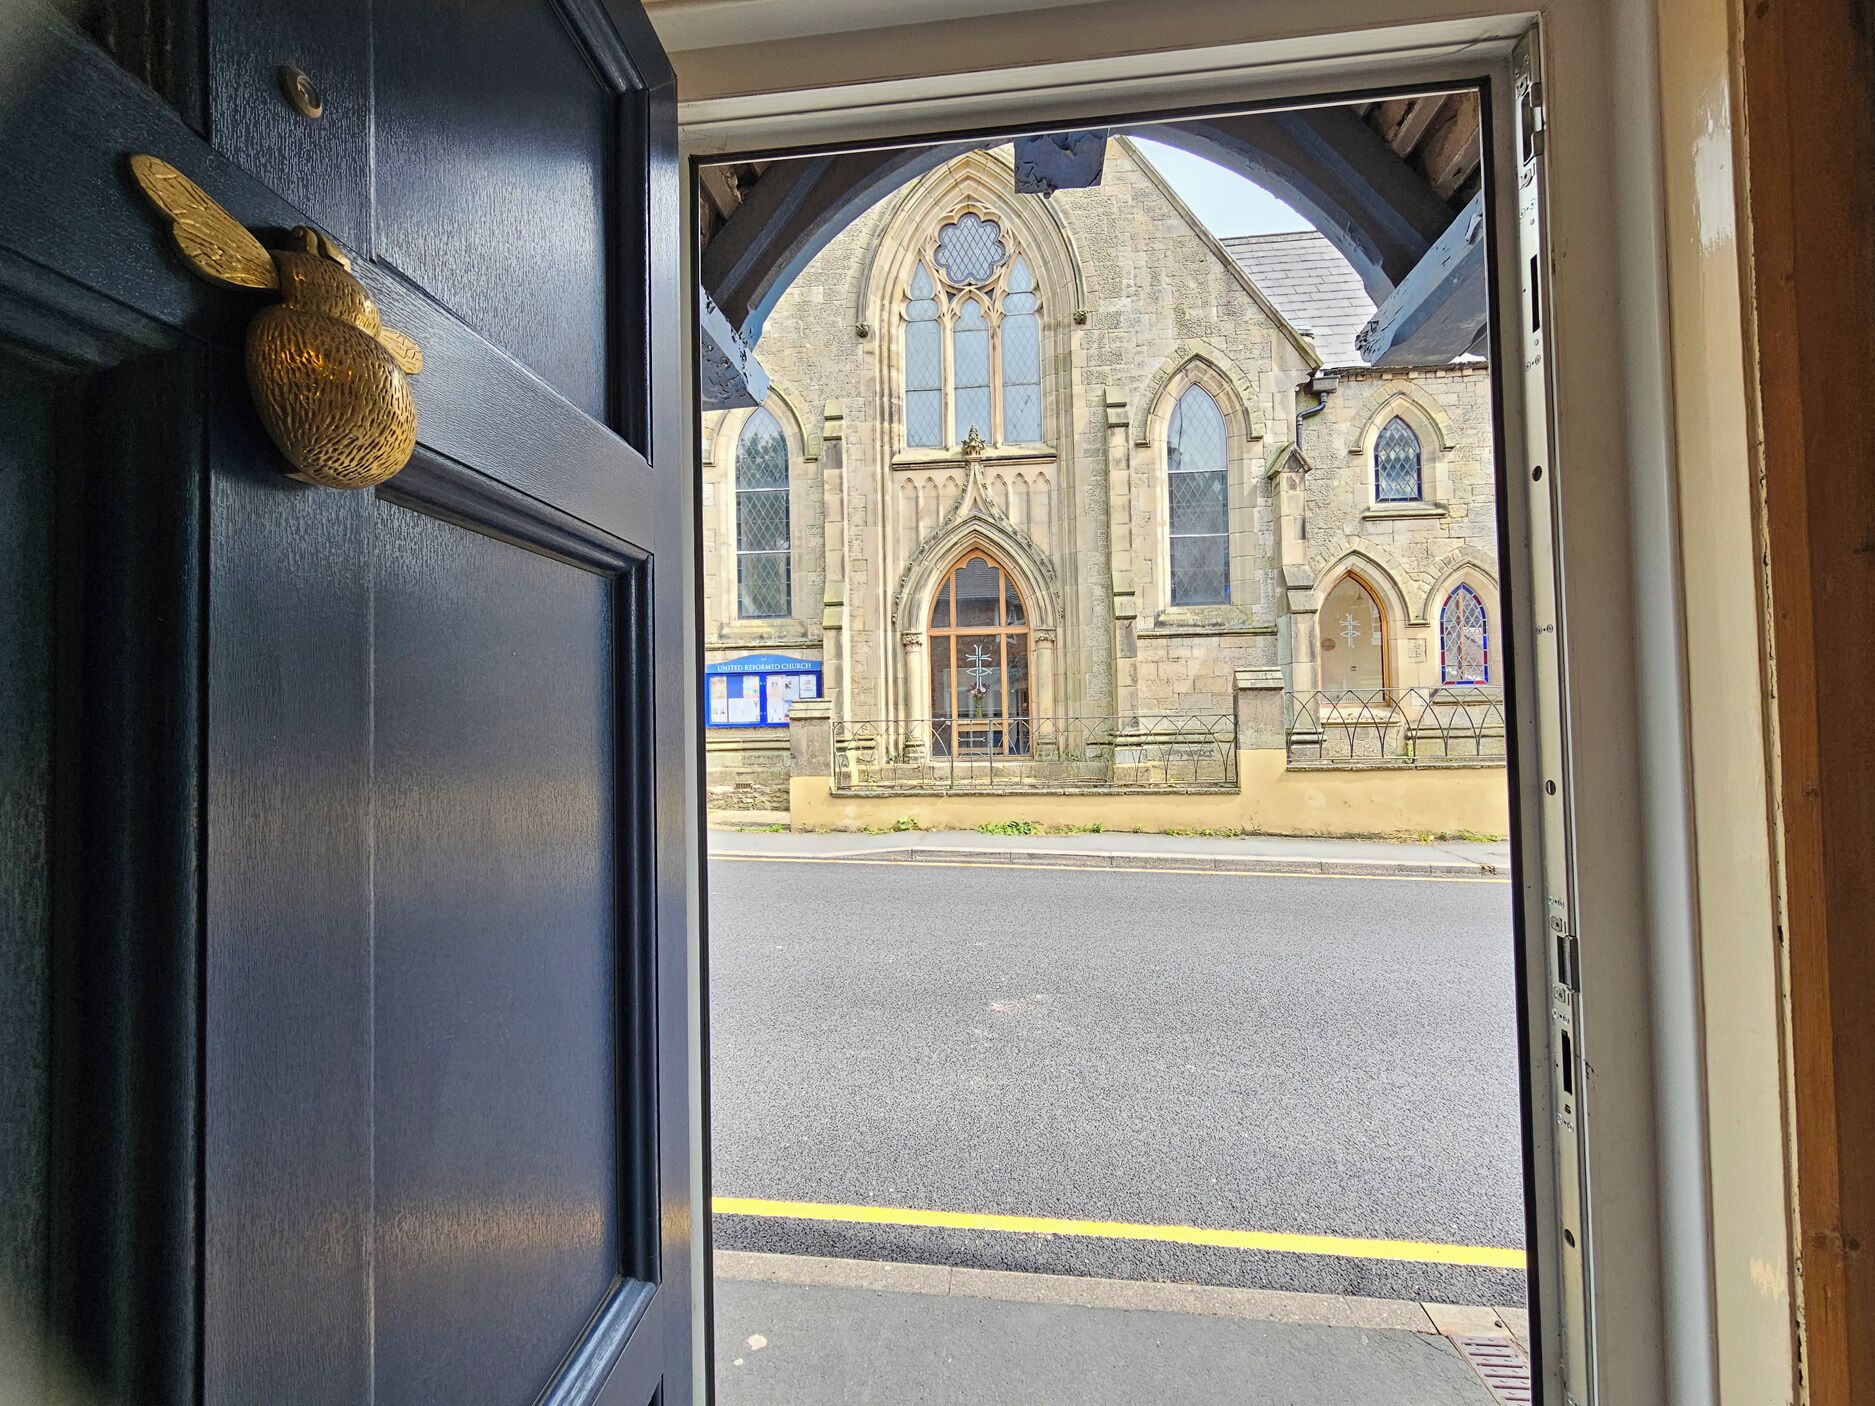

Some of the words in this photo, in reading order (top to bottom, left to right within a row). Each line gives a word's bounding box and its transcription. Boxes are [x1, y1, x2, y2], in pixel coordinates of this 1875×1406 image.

[717, 664, 744, 672] UNITED
[745, 663, 779, 671] REFORMED
[781, 662, 812, 670] CHURCH
